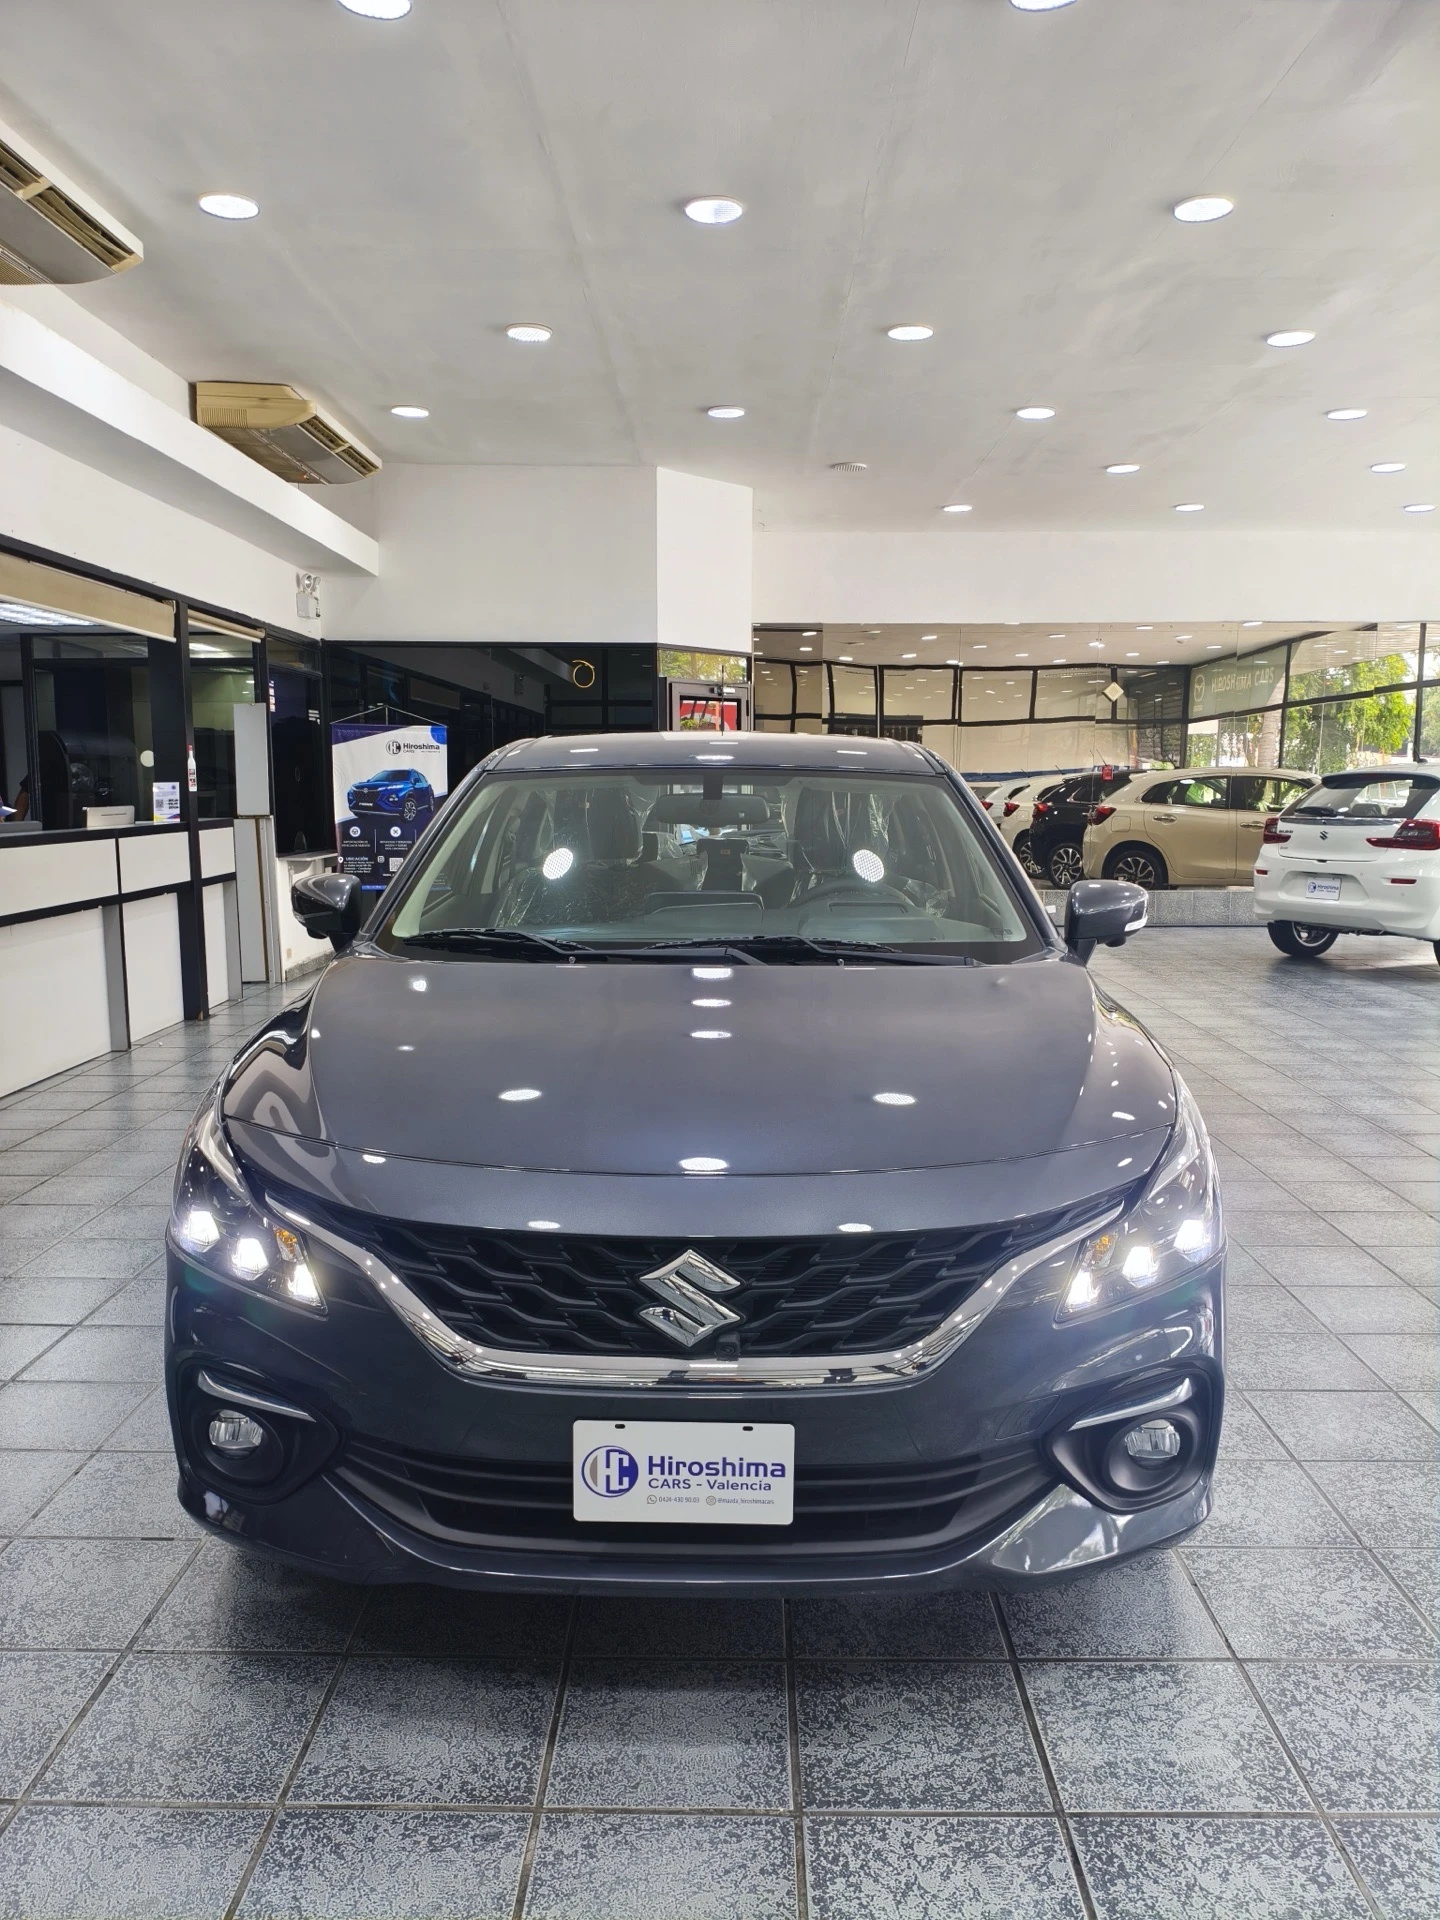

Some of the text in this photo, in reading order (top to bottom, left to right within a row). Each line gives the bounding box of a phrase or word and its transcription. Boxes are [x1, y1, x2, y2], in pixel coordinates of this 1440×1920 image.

[648, 1455, 786, 1478] Hiroshima
[648, 1478, 691, 1490] CARS
[706, 1479, 772, 1491] Valencia
